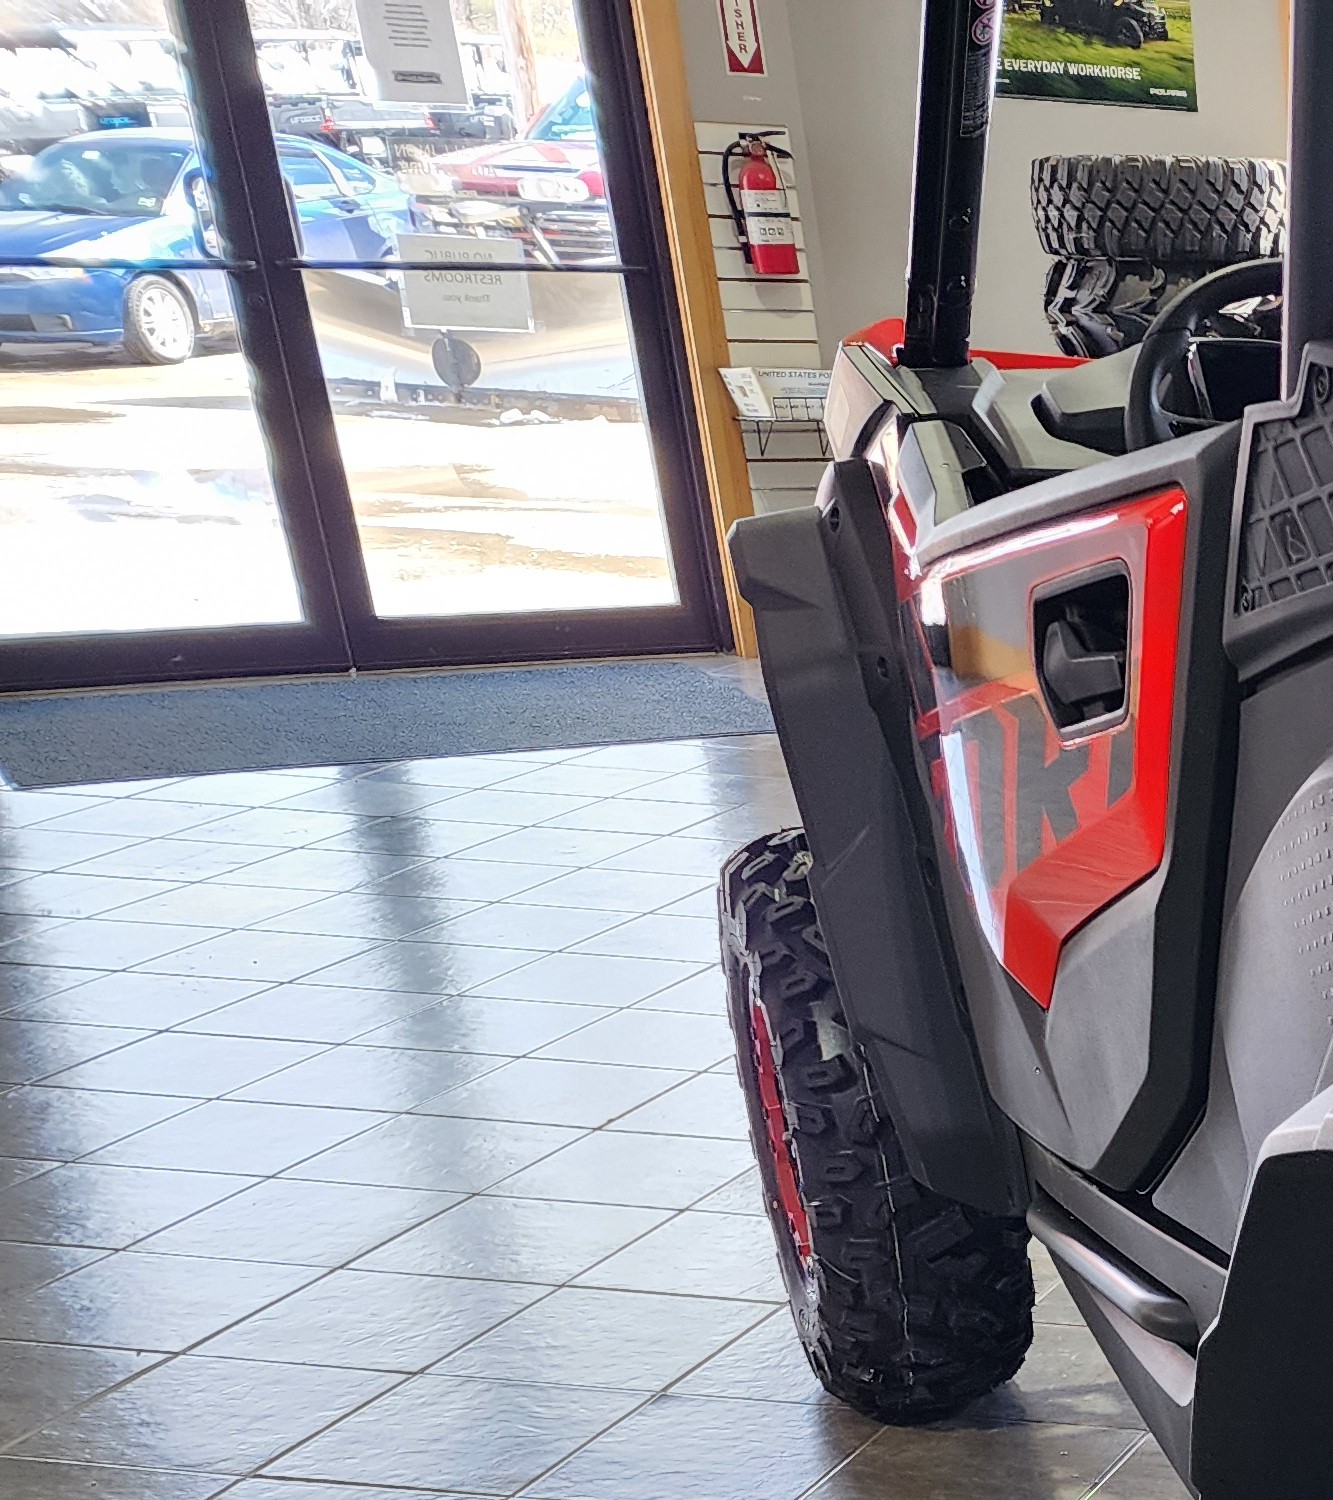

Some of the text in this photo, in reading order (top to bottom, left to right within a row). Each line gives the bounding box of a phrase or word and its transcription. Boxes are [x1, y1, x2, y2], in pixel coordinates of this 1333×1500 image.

[1004, 58, 1065, 75] EVERYDAY
[1066, 63, 1141, 80] WORKHORSE
[788, 371, 817, 379] STATES
